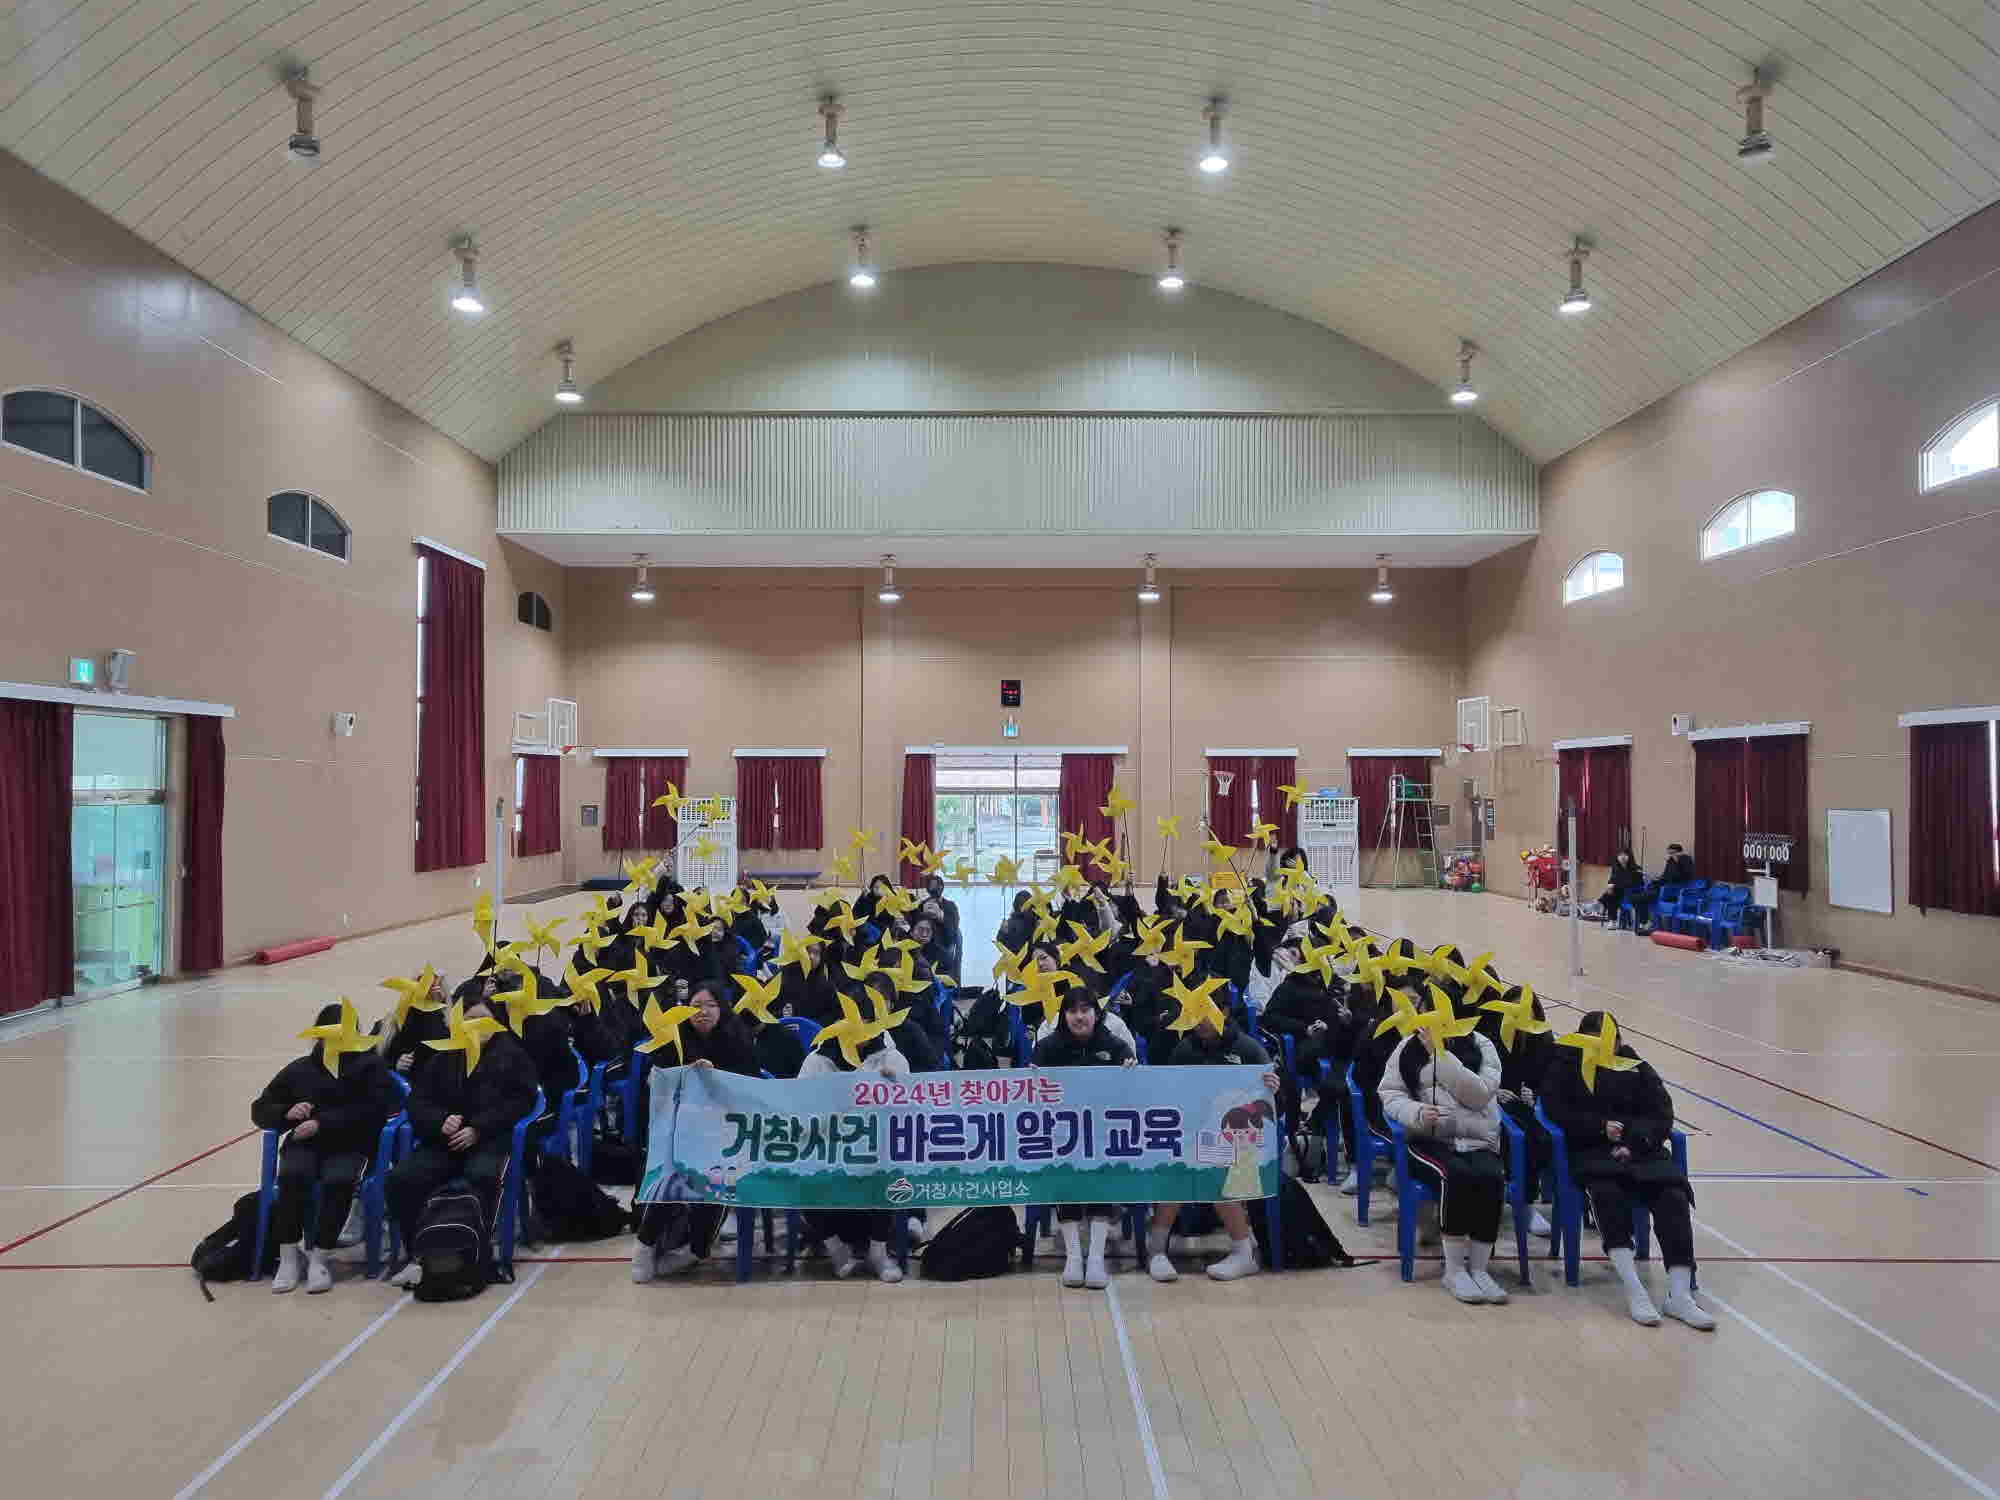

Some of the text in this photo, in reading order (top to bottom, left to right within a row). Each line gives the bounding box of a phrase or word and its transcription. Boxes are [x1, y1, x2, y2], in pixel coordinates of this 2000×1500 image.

[854, 1077, 1064, 1107] 2024년 찾아가는
[721, 1108, 1184, 1165] 거창사건 바르게 알기 교육
[915, 1178, 1032, 1201] 거창사건사업소
